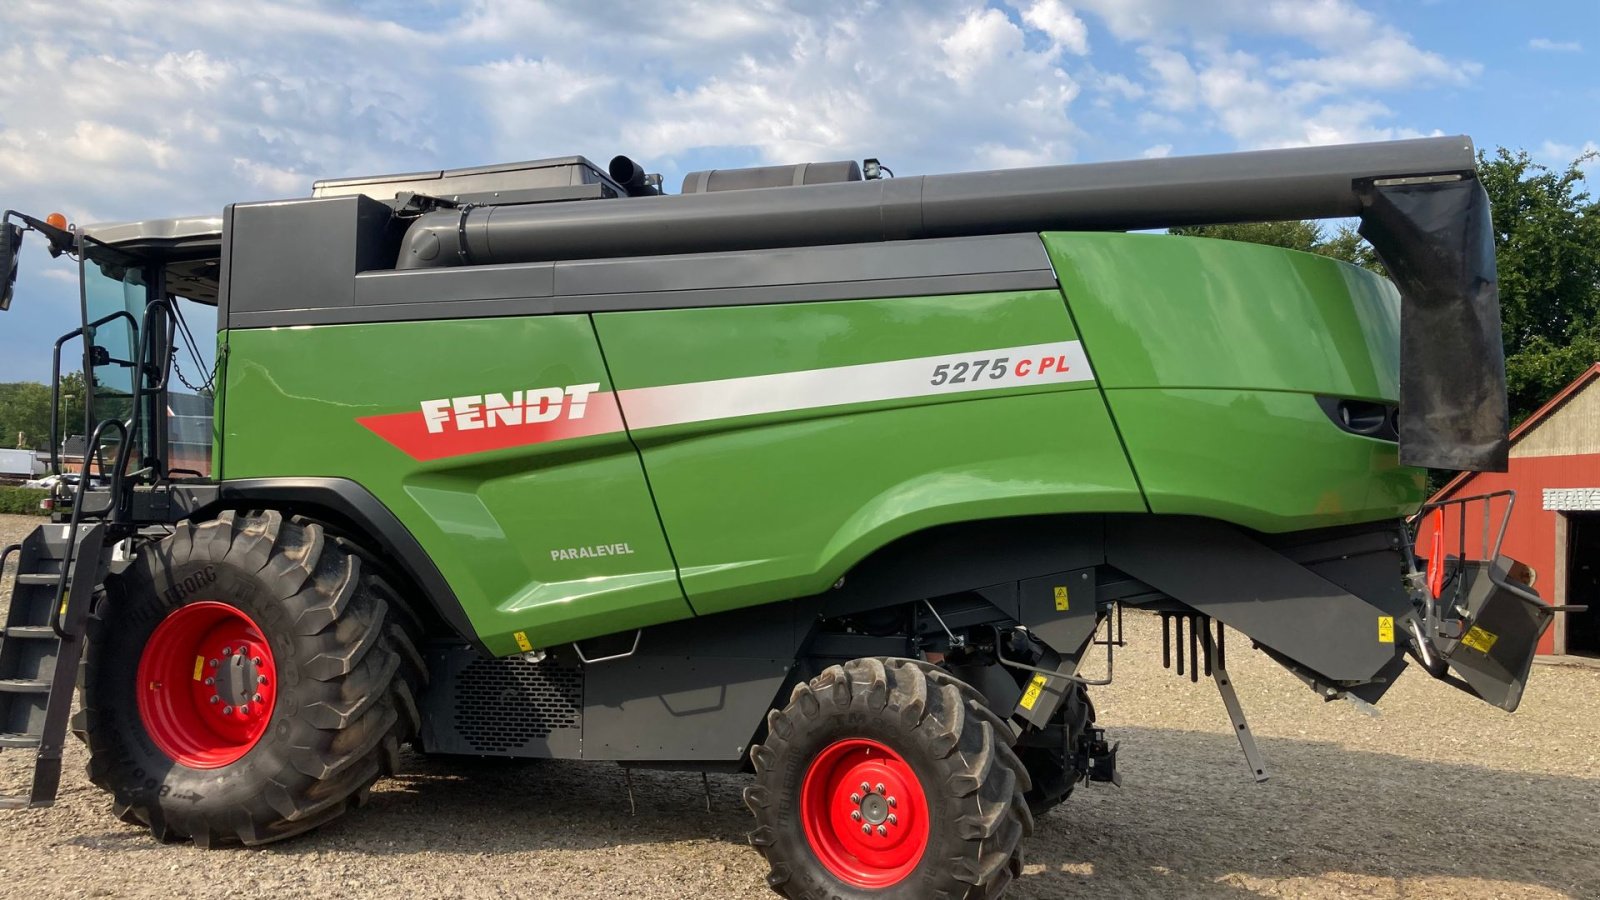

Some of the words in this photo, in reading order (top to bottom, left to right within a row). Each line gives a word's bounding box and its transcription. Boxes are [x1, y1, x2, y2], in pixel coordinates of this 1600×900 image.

[930, 357, 1010, 386] 5275
[1014, 359, 1032, 377] C
[1038, 355, 1070, 375] PL
[420, 382, 601, 434] FENDT
[550, 542, 635, 561] PARALEVEL
